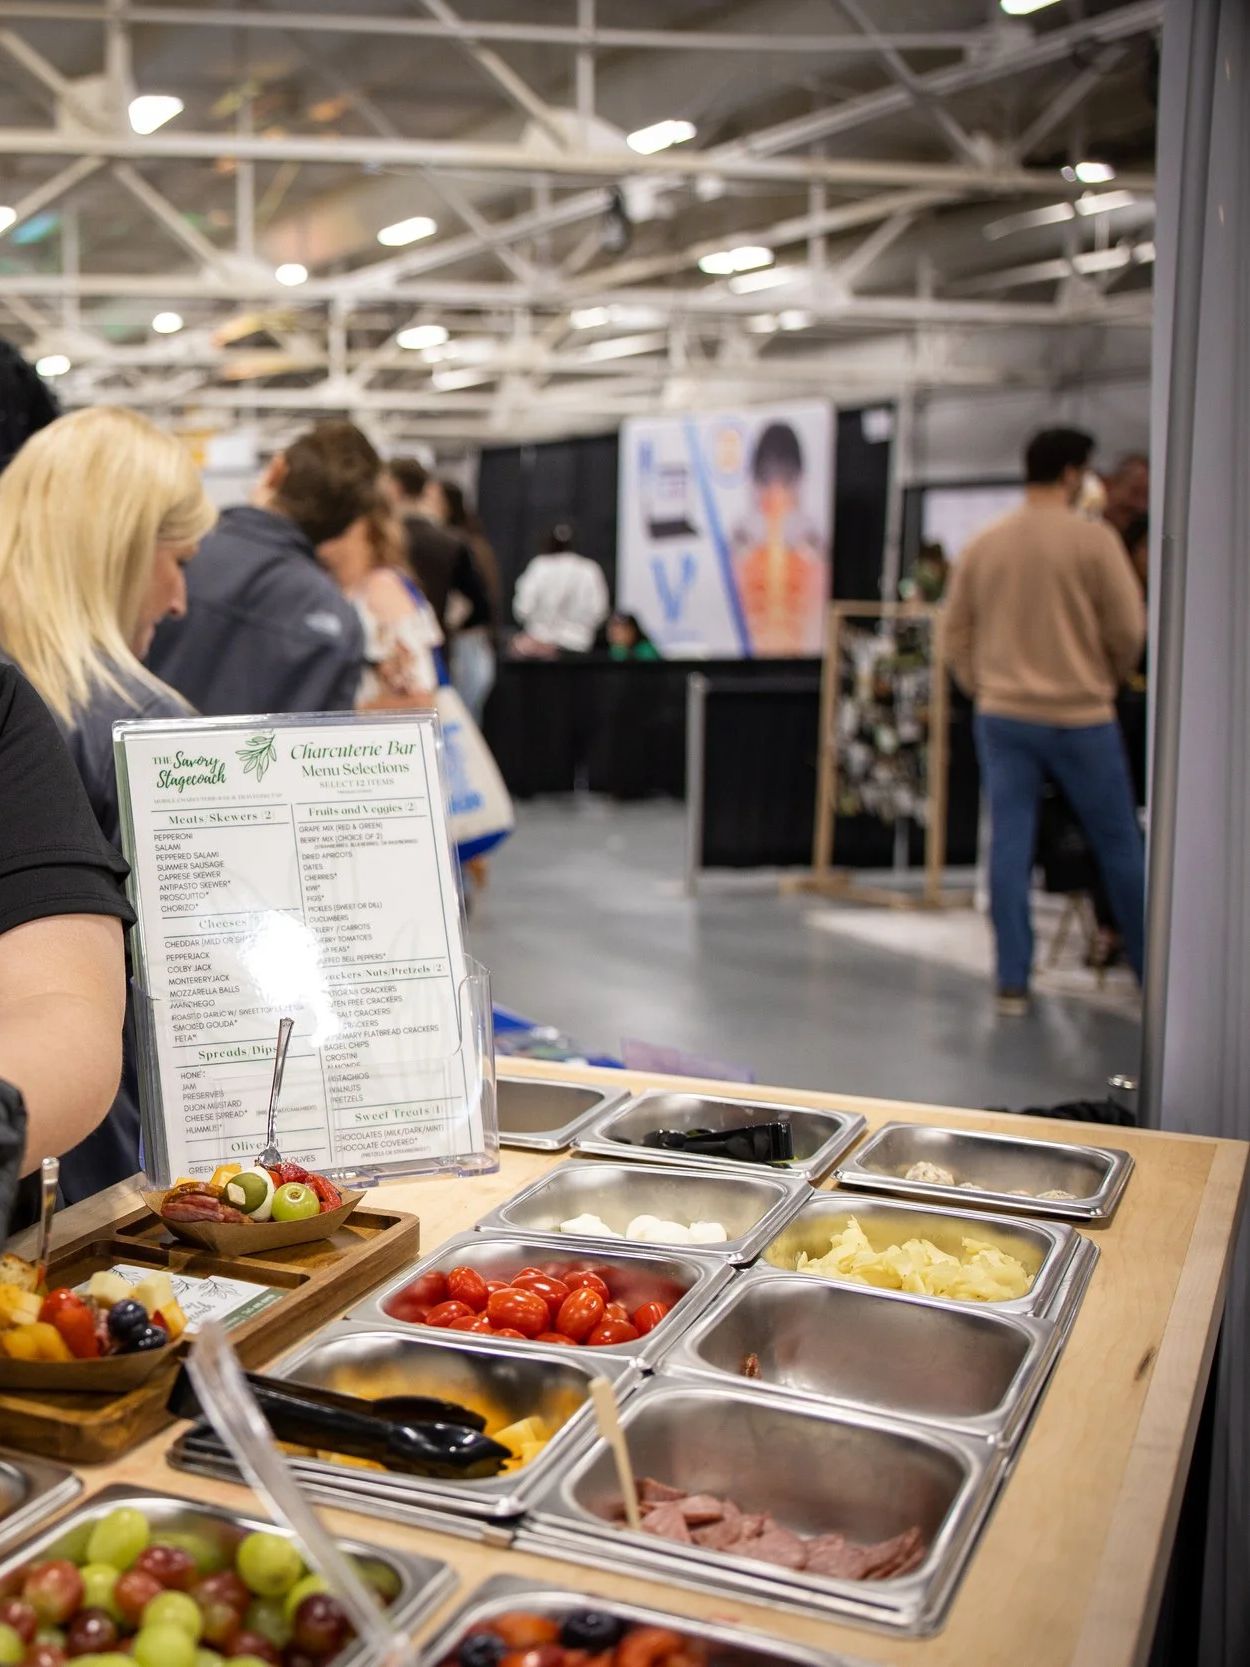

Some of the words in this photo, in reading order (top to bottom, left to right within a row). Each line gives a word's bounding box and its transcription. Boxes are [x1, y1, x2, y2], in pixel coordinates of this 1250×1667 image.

[291, 741, 383, 760] Charcuterie
[388, 740, 417, 756] Bar
[152, 756, 172, 765] THE
[173, 751, 220, 773] Savory
[302, 764, 340, 778] Menu
[342, 762, 410, 776] Selections
[156, 763, 226, 793] Stagecoach
[320, 780, 353, 789] SELECT
[356, 779, 366, 787] 12
[367, 778, 394, 786] ITEMS
[308, 807, 339, 817] Fruits
[341, 805, 361, 815] and
[361, 803, 403, 815] Veggies
[299, 824, 321, 833] GRAPE
[323, 823, 334, 831] MIX
[336, 823, 350, 832] (RED
[359, 821, 383, 830] GREEN)
[154, 833, 192, 841] PEPPERONI
[300, 836, 320, 844] BERRY
[322, 835, 334, 843] MIX
[335, 834, 363, 843] (CHOICE
[365, 833, 374, 841] OF
[156, 853, 192, 861] PEPPERED
[194, 851, 219, 859] SALAMI
[302, 853, 321, 861] DRIED
[322, 851, 353, 859] APRICOTS
[157, 863, 188, 872] SUMMER
[190, 861, 225, 870] SAUSAGE
[303, 863, 323, 871] DATES
[158, 872, 190, 881] CAPRESE
[193, 871, 220, 880] SKEWER
[159, 883, 198, 891] ANTIPASTO
[308, 904, 332, 913] PICKLES
[334, 903, 356, 912] (SWEET
[368, 901, 383, 909] DILL)
[309, 914, 349, 923] CUCUMBERS
[199, 919, 247, 930] Cheeses
[340, 923, 371, 932] CARROTS
[165, 939, 199, 949] CHEDDAR
[201, 937, 221, 948] (MILD
[222, 936, 234, 944] OR
[338, 934, 373, 942] TOMATOES
[166, 952, 210, 962] PEPPERJACK
[342, 955, 356, 963] BELL
[167, 965, 192, 974] COLBY
[194, 963, 212, 972] JACK
[325, 965, 431, 981] ackers/Nuts/Pretzels
[170, 987, 218, 998] MOZZARELLA
[219, 985, 240, 994] BALLS
[360, 985, 398, 995] CRACKERS
[170, 999, 215, 1009] MANCHEGO
[366, 995, 403, 1005] CRACKERS
[171, 1012, 202, 1021] ROASTED
[203, 1010, 227, 1019] GARLIC
[228, 1009, 237, 1017] W/
[238, 1007, 259, 1015] SWEET
[337, 1010, 352, 1019] SALT
[354, 1008, 391, 1017] CRACKERS
[173, 1022, 205, 1031] SMOKED
[335, 1031, 362, 1040] EMARY
[364, 1028, 402, 1038] FLATBREAD
[403, 1025, 439, 1034] CRACKERS
[324, 1043, 347, 1052] BAGEL
[349, 1040, 370, 1049] CHIPS
[325, 1052, 358, 1062] CROSTINI
[182, 1082, 197, 1091] JAM
[329, 1083, 362, 1093] WALNUTS
[183, 1090, 224, 1100] PRESERVES
[331, 1094, 364, 1104] PRETZELS
[184, 1103, 206, 1112] DIJON
[207, 1100, 242, 1110] MUSTARD
[184, 1114, 214, 1123] CHEESE
[355, 1110, 389, 1122] Sweet
[392, 1106, 429, 1119] Treats
[334, 1131, 383, 1142] CHOCOLATES
[335, 1142, 379, 1153] CHOCOLATE
[290, 1154, 316, 1164] OLIVES
[188, 1165, 214, 1175] GREEN
